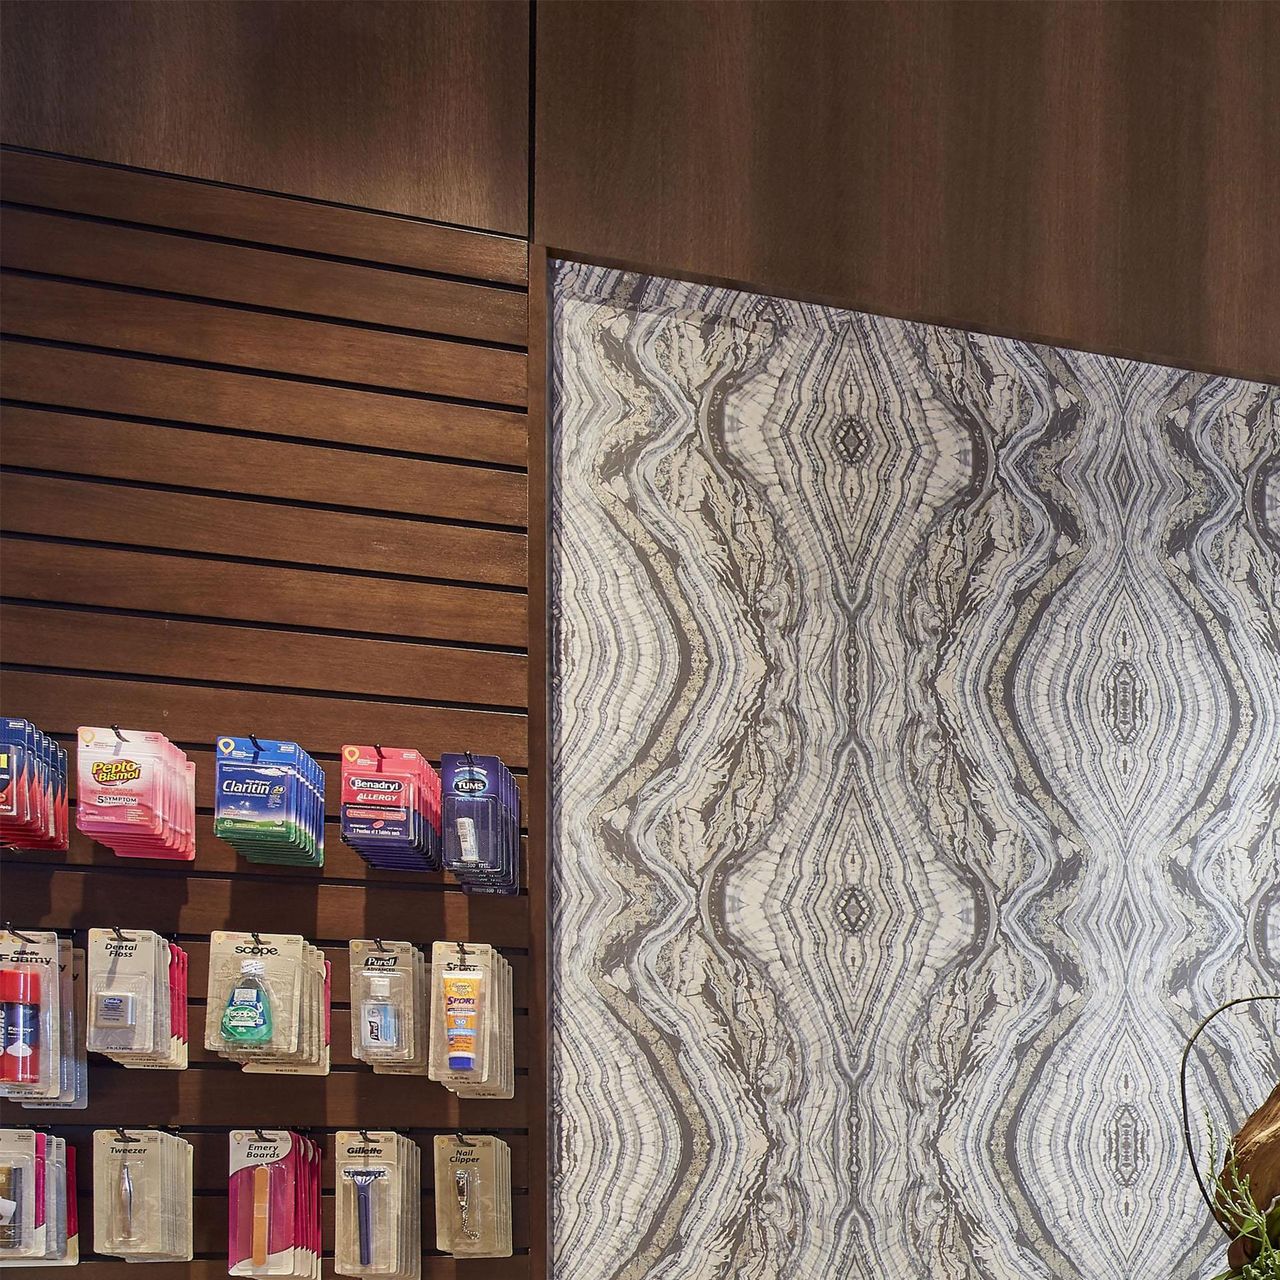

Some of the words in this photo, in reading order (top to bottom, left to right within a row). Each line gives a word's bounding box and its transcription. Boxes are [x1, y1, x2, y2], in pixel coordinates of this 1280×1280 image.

[92, 759, 137, 775] Pepto
[98, 770, 141, 782] Bismol
[222, 780, 270, 794] Claritin
[355, 780, 399, 790] Benadryl
[458, 781, 484, 790] TUMS
[357, 793, 397, 801] ALLERGY
[105, 943, 137, 951] Dental
[235, 946, 278, 956] scope
[109, 950, 133, 958] Floss
[0, 954, 52, 965] Foamy
[367, 957, 397, 966] Purell
[446, 963, 478, 972] SPORT
[447, 997, 476, 1005] SPORT
[230, 1010, 257, 1019] scope
[248, 1144, 279, 1153] Emery
[346, 1147, 382, 1155] Gillette
[456, 1149, 474, 1157] Nail
[246, 1151, 280, 1159] Boards
[449, 1156, 480, 1164] Clipper
